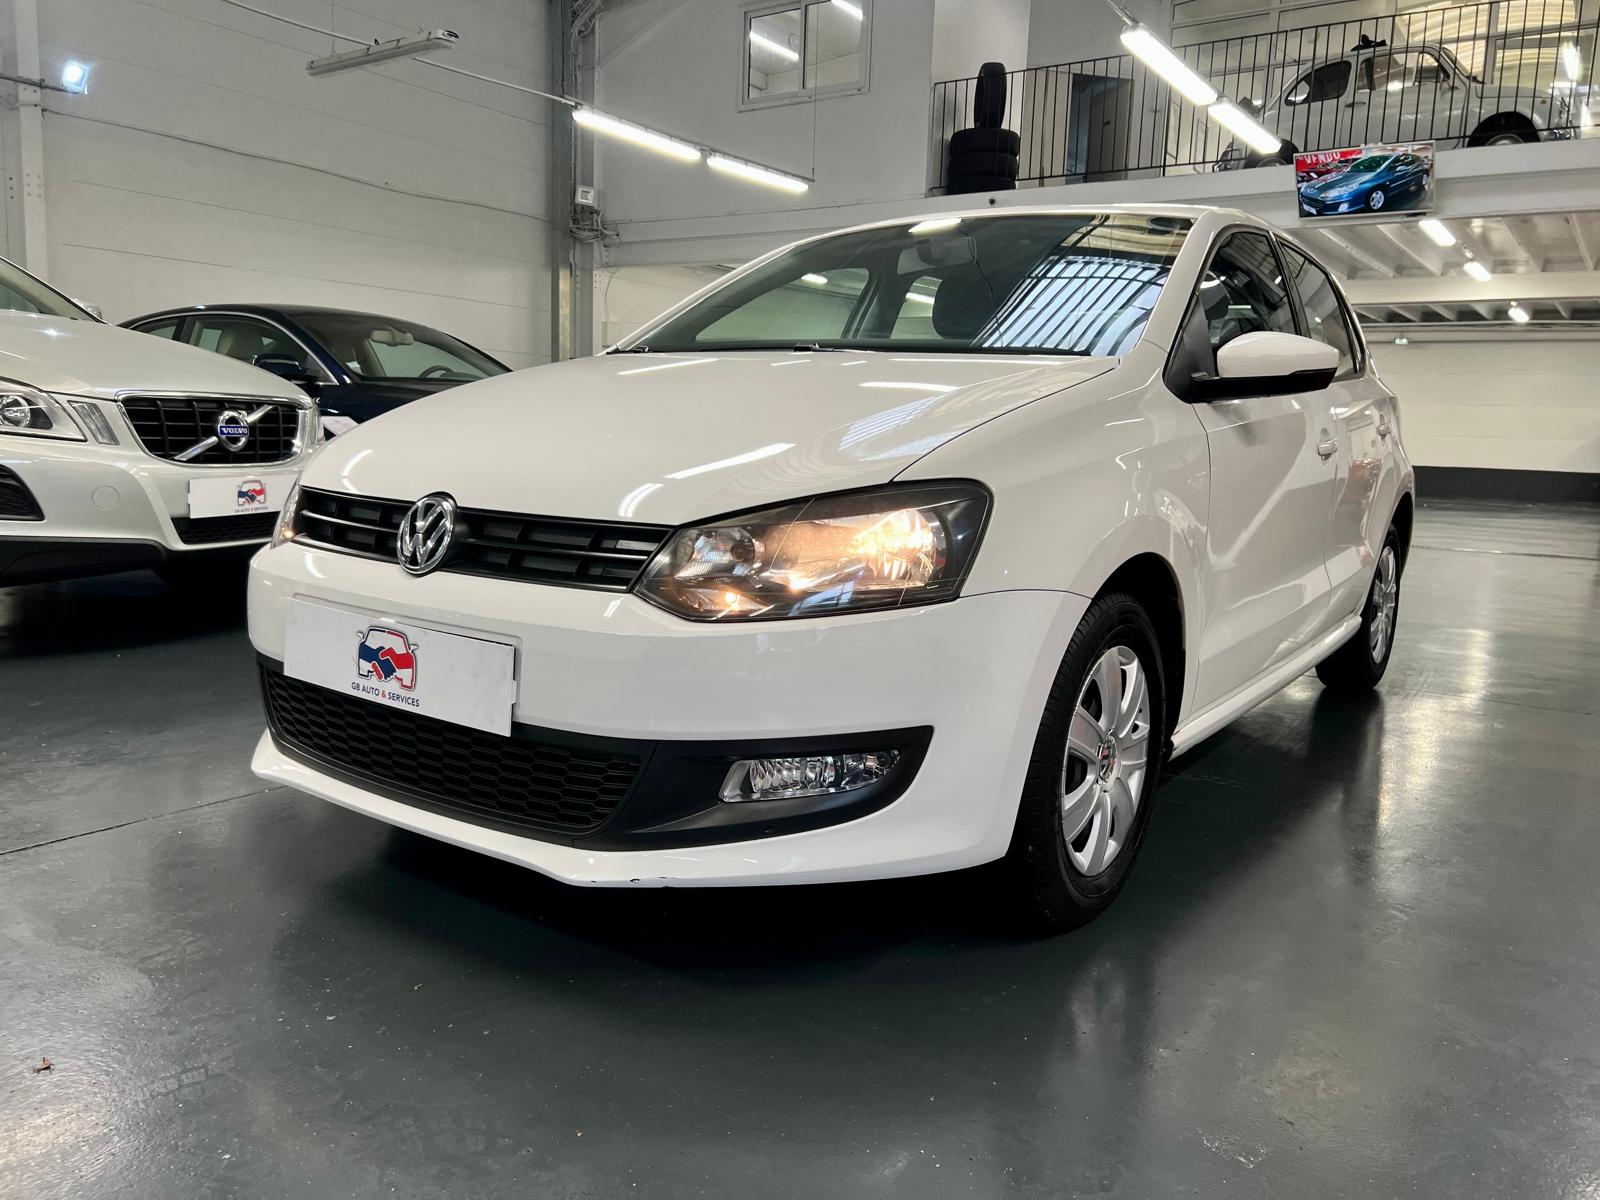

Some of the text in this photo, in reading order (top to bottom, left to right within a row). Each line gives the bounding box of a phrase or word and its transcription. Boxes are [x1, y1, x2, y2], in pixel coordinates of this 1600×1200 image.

[351, 681, 420, 707] GB AUTO & SERVICES
